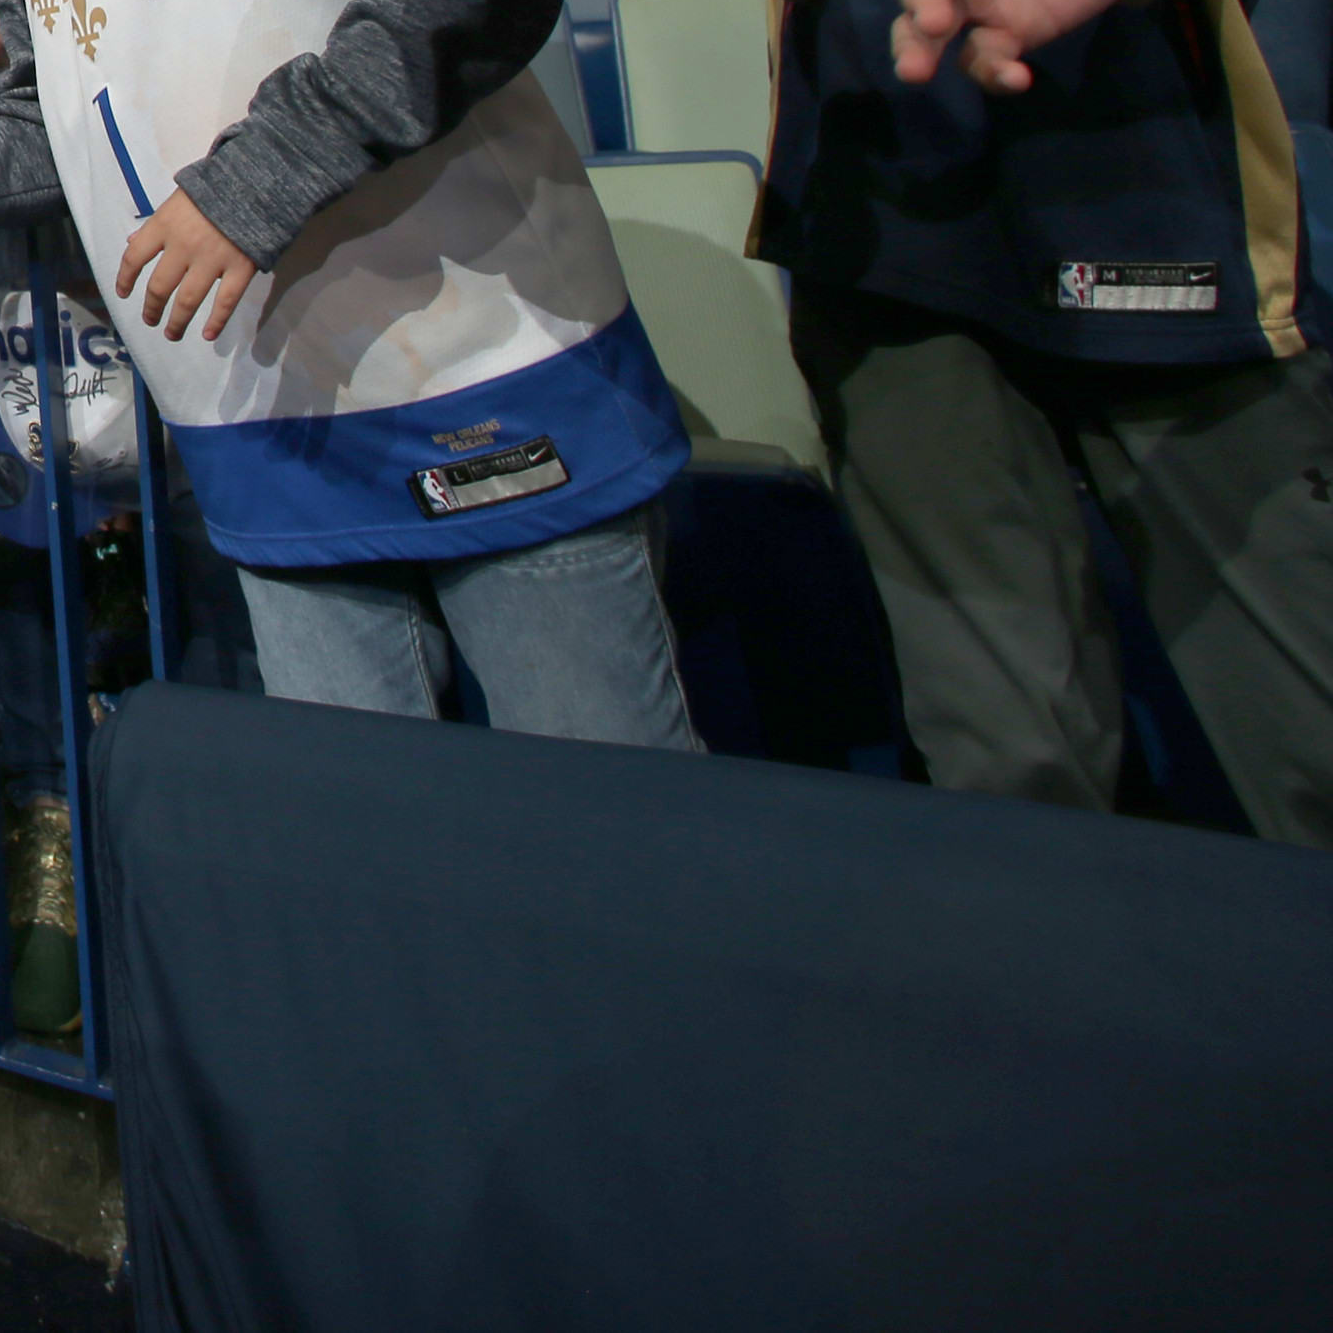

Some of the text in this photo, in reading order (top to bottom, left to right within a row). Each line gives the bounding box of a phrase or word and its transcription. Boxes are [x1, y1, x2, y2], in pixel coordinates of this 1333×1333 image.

[431, 418, 502, 446] NEW ORLEANS
[448, 434, 495, 453] PELICANS
